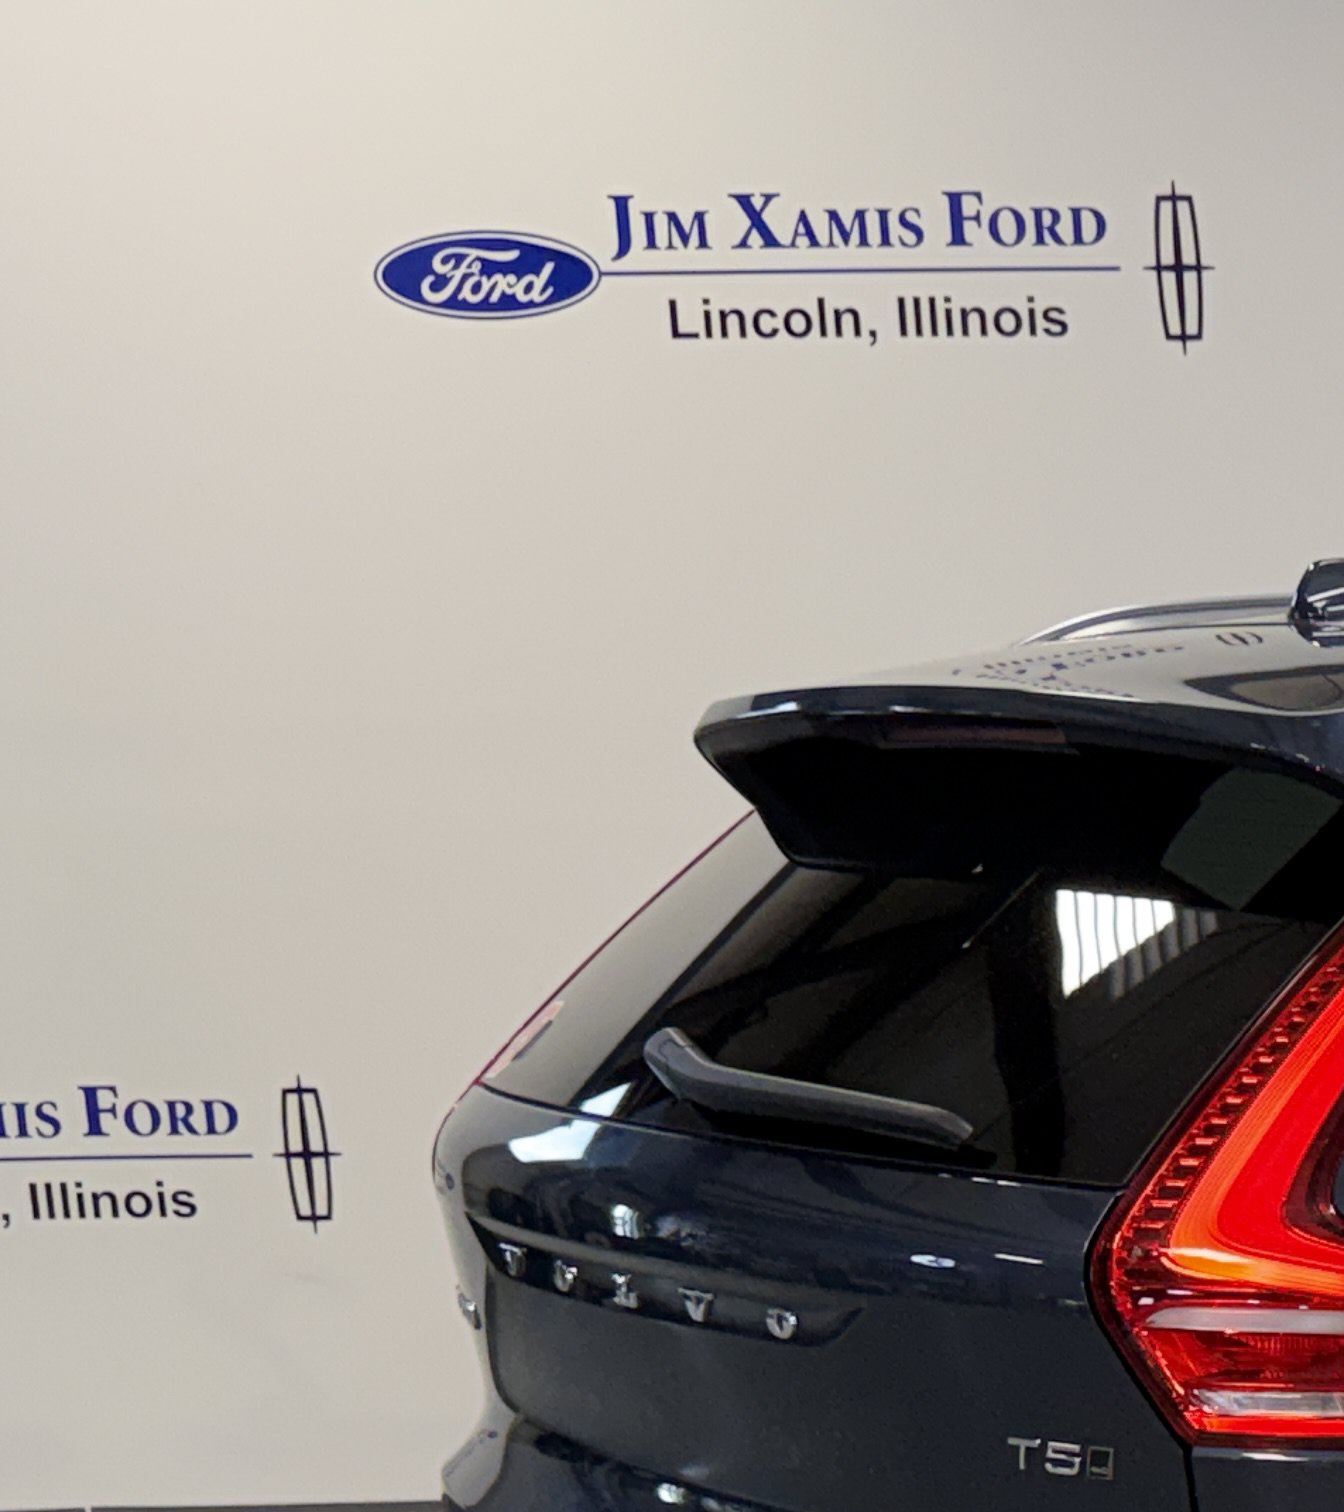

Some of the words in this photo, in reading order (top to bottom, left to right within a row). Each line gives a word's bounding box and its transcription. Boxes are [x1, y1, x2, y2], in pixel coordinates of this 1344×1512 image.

[606, 193, 713, 262] JIM
[727, 191, 926, 251] XAMIS
[941, 189, 1108, 249] FORD
[420, 246, 556, 305] Ford
[667, 296, 879, 347] Lincoln,
[897, 295, 1070, 339] Illinois
[0, 1100, 63, 1139] IS
[77, 1085, 240, 1138] FORD
[28, 1180, 199, 1221] Illinois
[1007, 1437, 1082, 1477] T5
